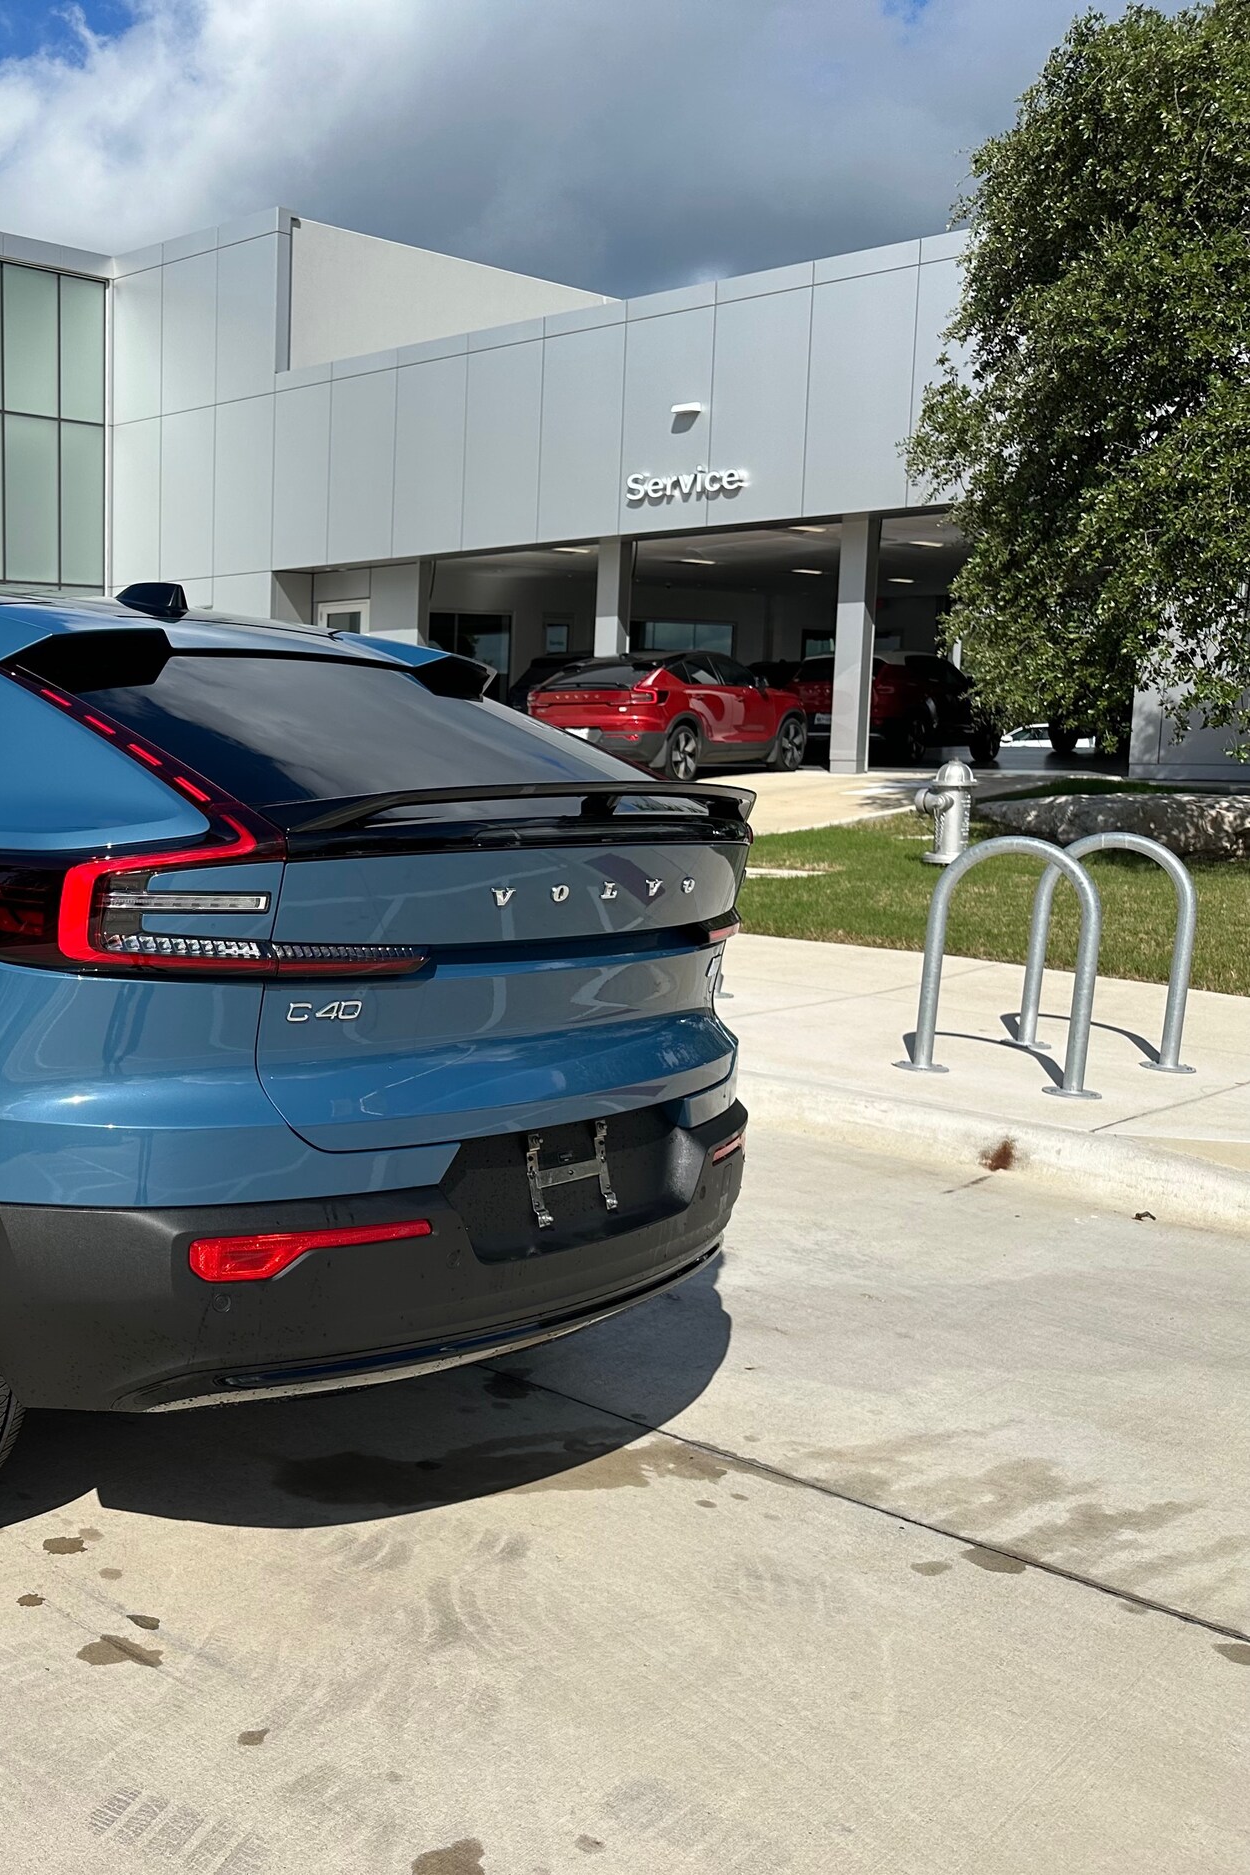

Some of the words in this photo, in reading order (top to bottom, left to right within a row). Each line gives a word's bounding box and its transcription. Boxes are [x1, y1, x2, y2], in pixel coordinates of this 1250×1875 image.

[626, 464, 742, 500] Service
[491, 877, 696, 906] VOLVO
[286, 1001, 362, 1021] C40
